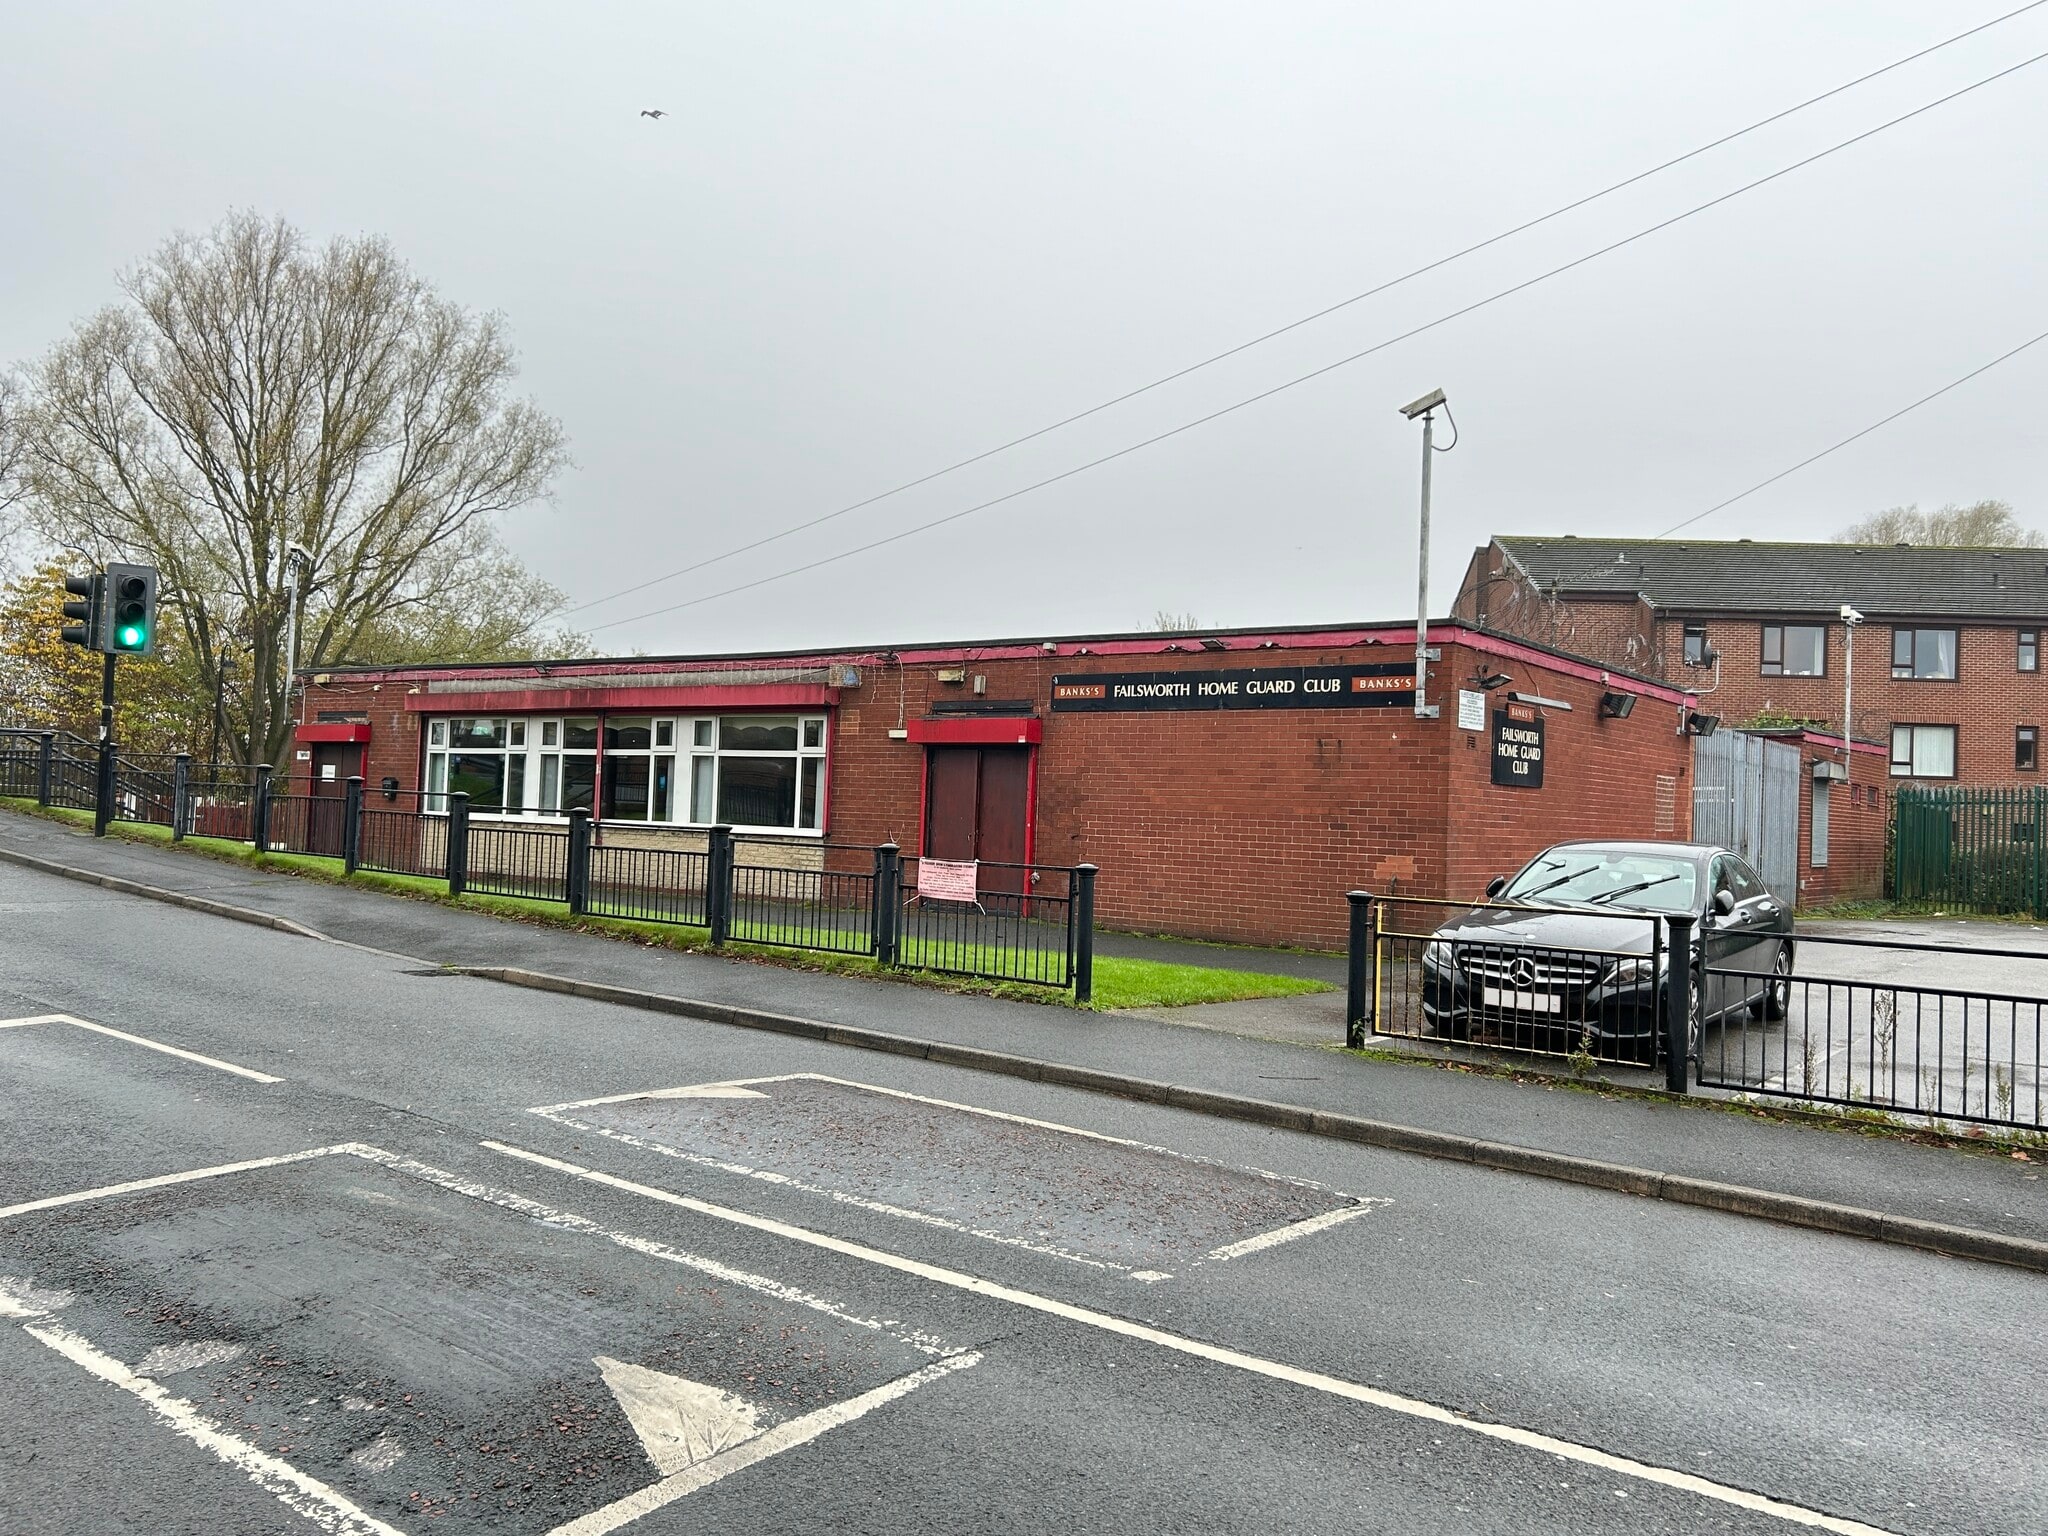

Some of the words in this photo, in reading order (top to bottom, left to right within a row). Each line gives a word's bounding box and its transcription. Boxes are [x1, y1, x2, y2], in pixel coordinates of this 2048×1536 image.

[1113, 683, 1190, 698] FAILSWORTH
[1198, 681, 1239, 695] HOME
[1246, 680, 1296, 694] GUARD
[1303, 678, 1341, 693] CLUB
[1359, 678, 1412, 689] BANKS'S
[1060, 687, 1100, 697] BANKS'S
[1502, 727, 1539, 745] FAILSWORTH
[1498, 743, 1518, 757] HOME
[1520, 746, 1541, 761] GUARD
[1512, 760, 1529, 775] CLUB
